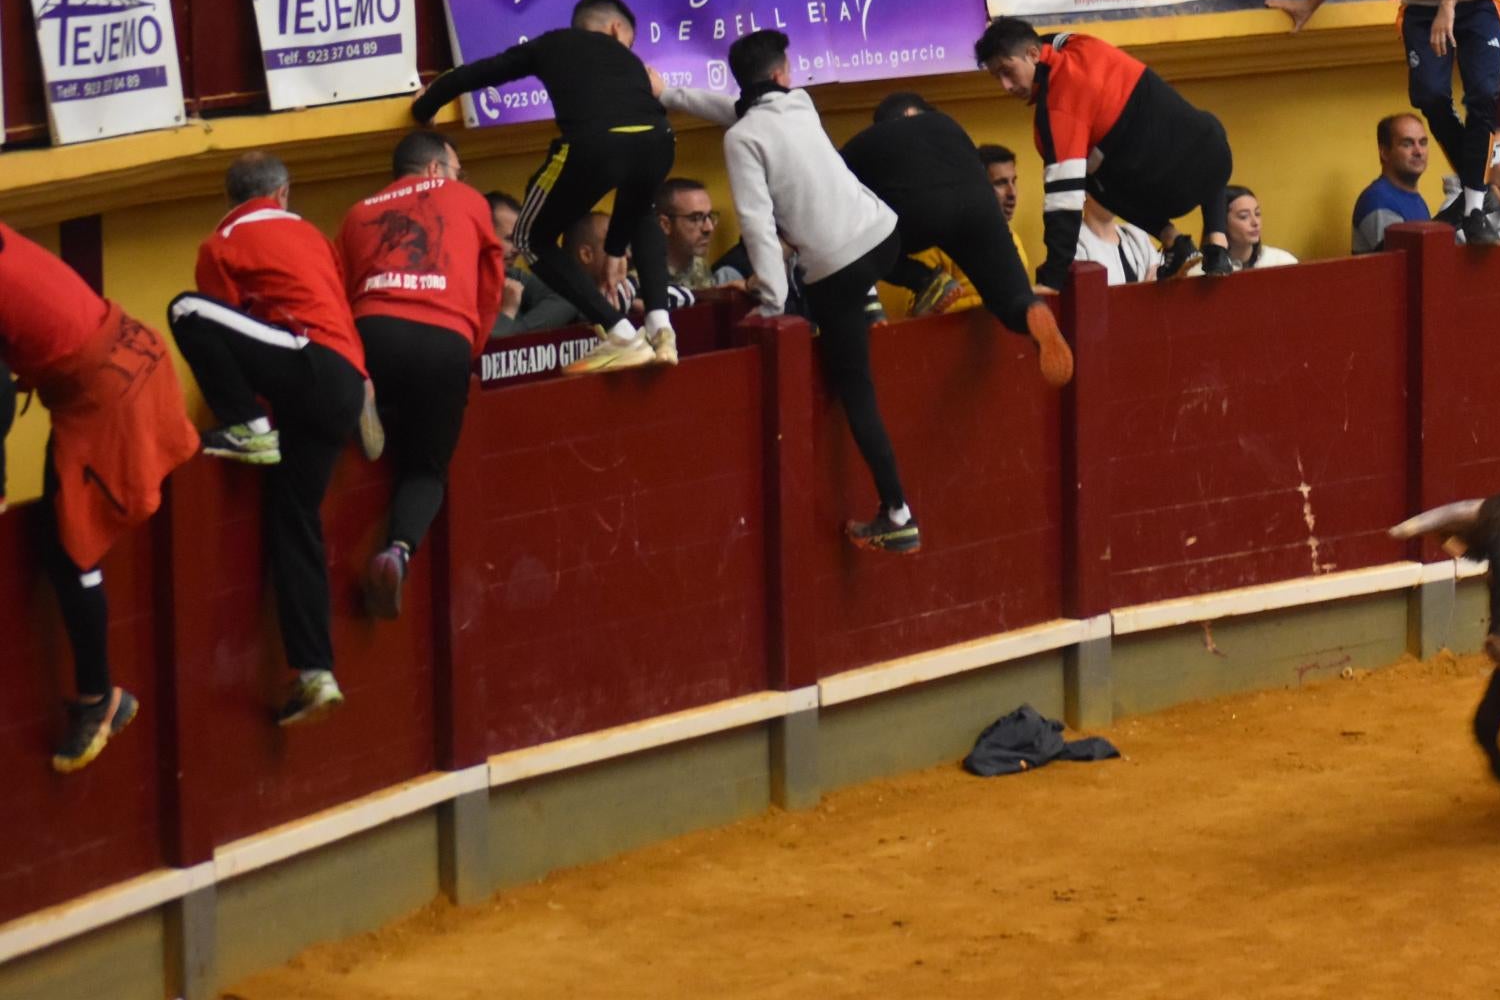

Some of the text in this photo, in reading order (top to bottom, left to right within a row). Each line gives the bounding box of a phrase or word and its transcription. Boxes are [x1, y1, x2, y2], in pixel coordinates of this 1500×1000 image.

[48, 0, 163, 67] TEJEMO
[650, 20, 693, 44] DE
[277, 41, 378, 66] Telf. 923 37 04 89
[503, 92, 529, 108] 923
[481, 342, 557, 382] DELEGADO
